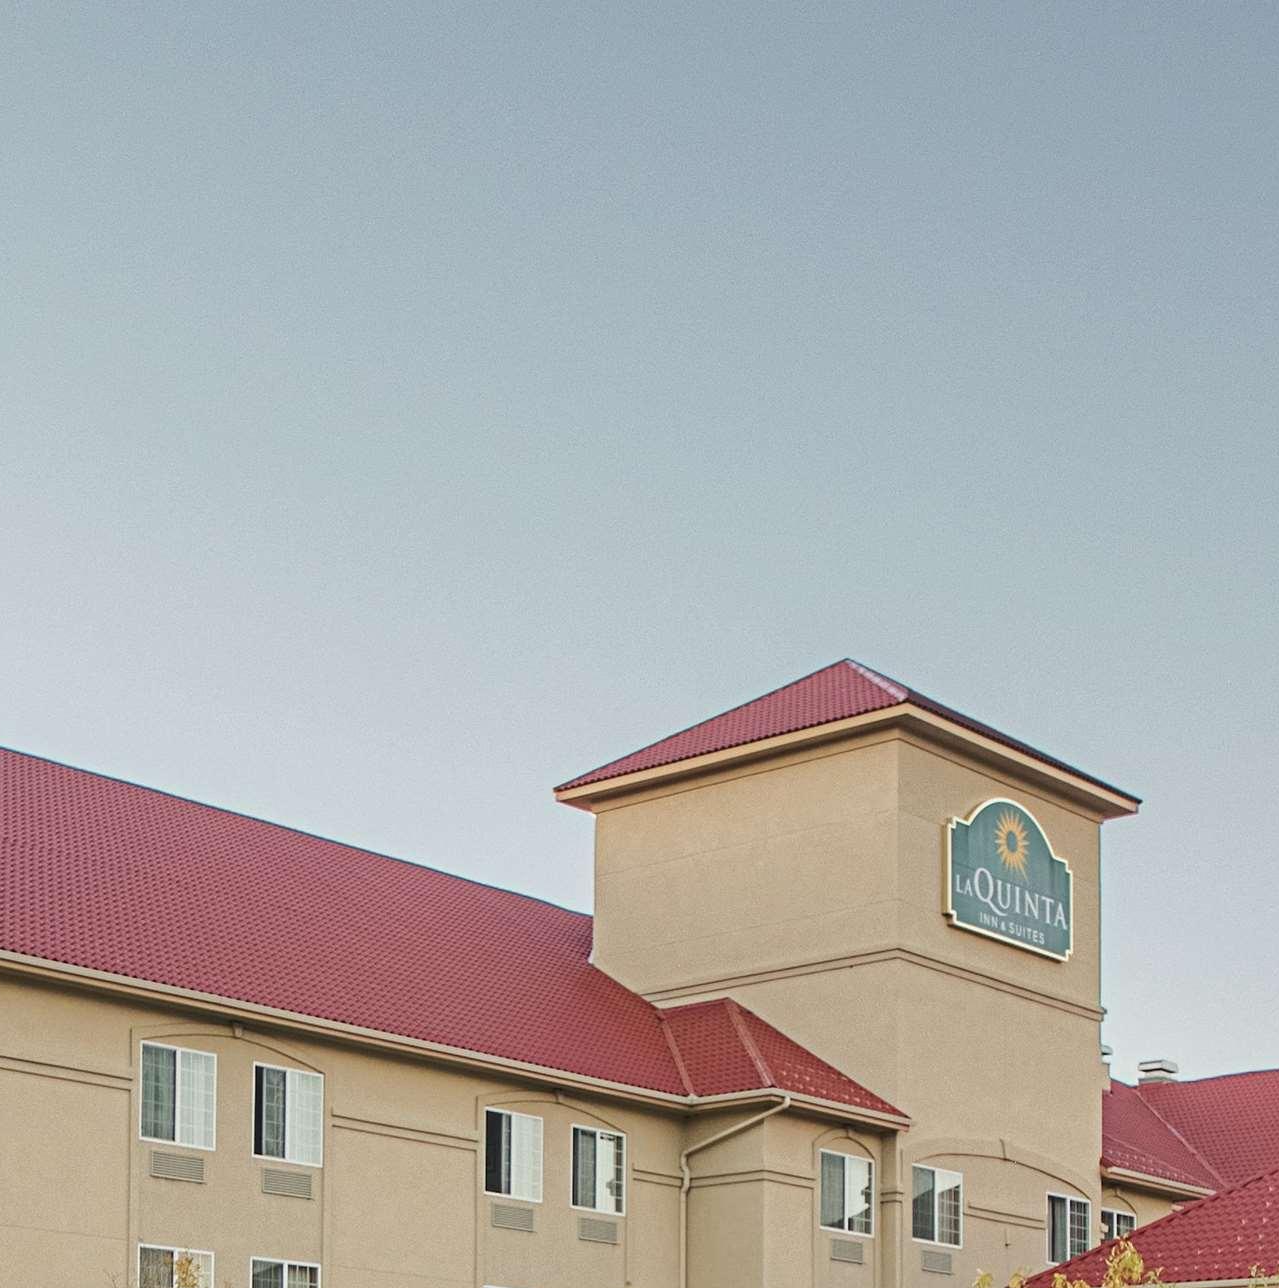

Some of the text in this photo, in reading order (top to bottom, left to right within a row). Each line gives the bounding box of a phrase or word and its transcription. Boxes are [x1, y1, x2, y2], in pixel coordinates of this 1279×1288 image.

[955, 867, 1068, 930] LA QUINTA
[980, 912, 999, 928] INN
[1009, 922, 1046, 945] SUITES
